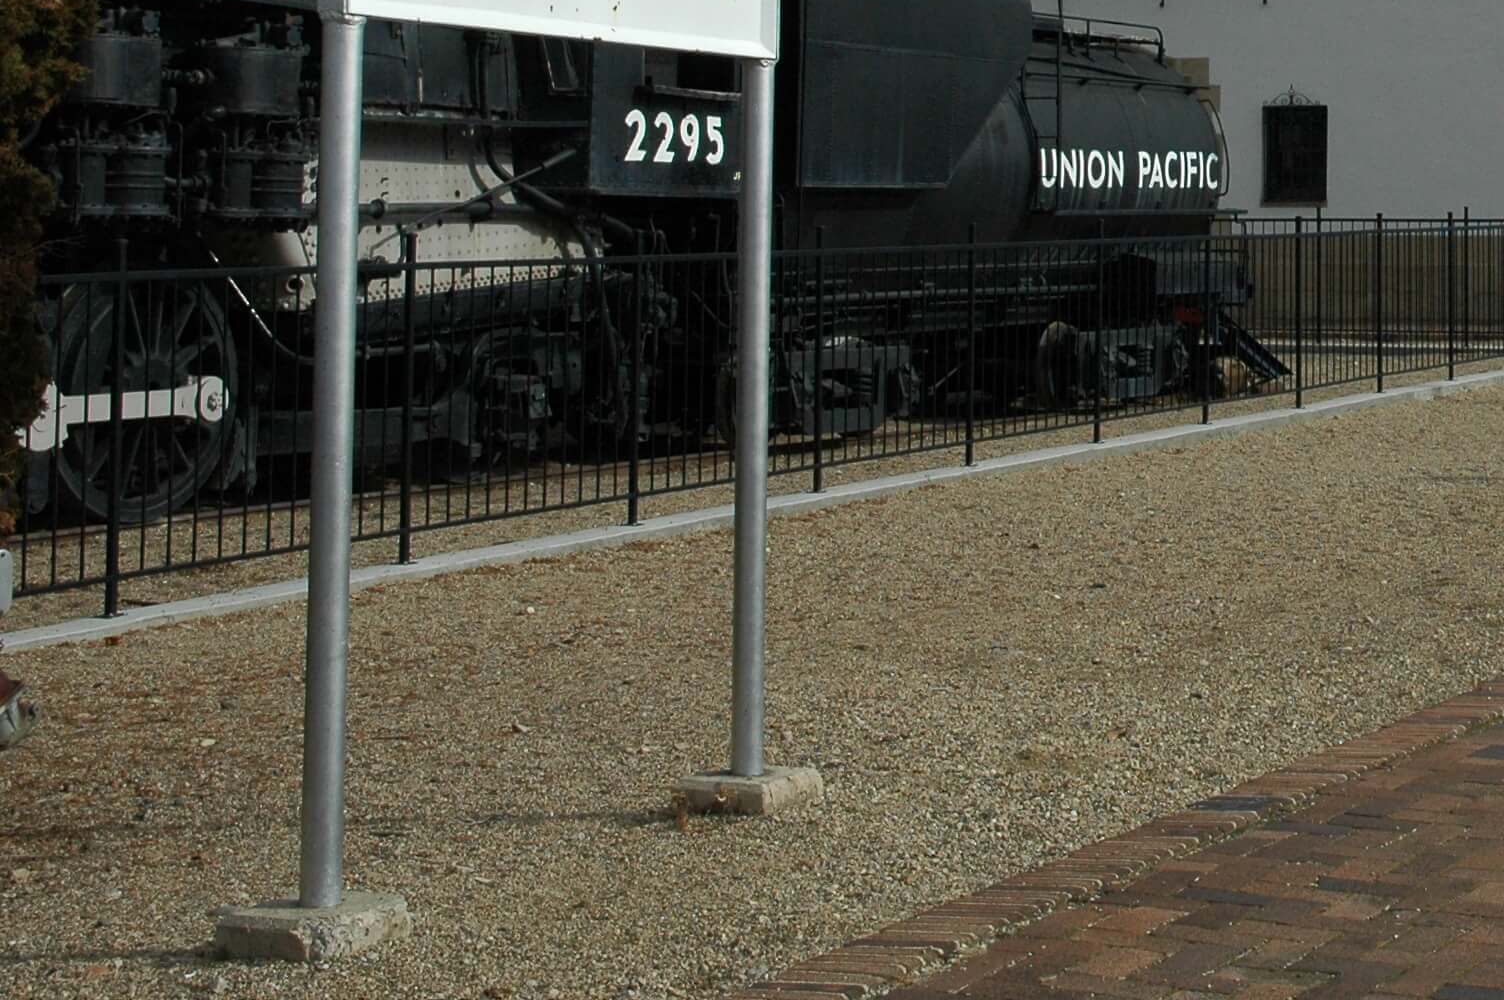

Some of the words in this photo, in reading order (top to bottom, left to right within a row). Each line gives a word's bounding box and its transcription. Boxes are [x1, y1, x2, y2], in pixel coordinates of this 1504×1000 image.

[624, 109, 724, 165] 2295
[1040, 148, 1124, 189] UNION
[1138, 151, 1218, 189] PACIFIC
